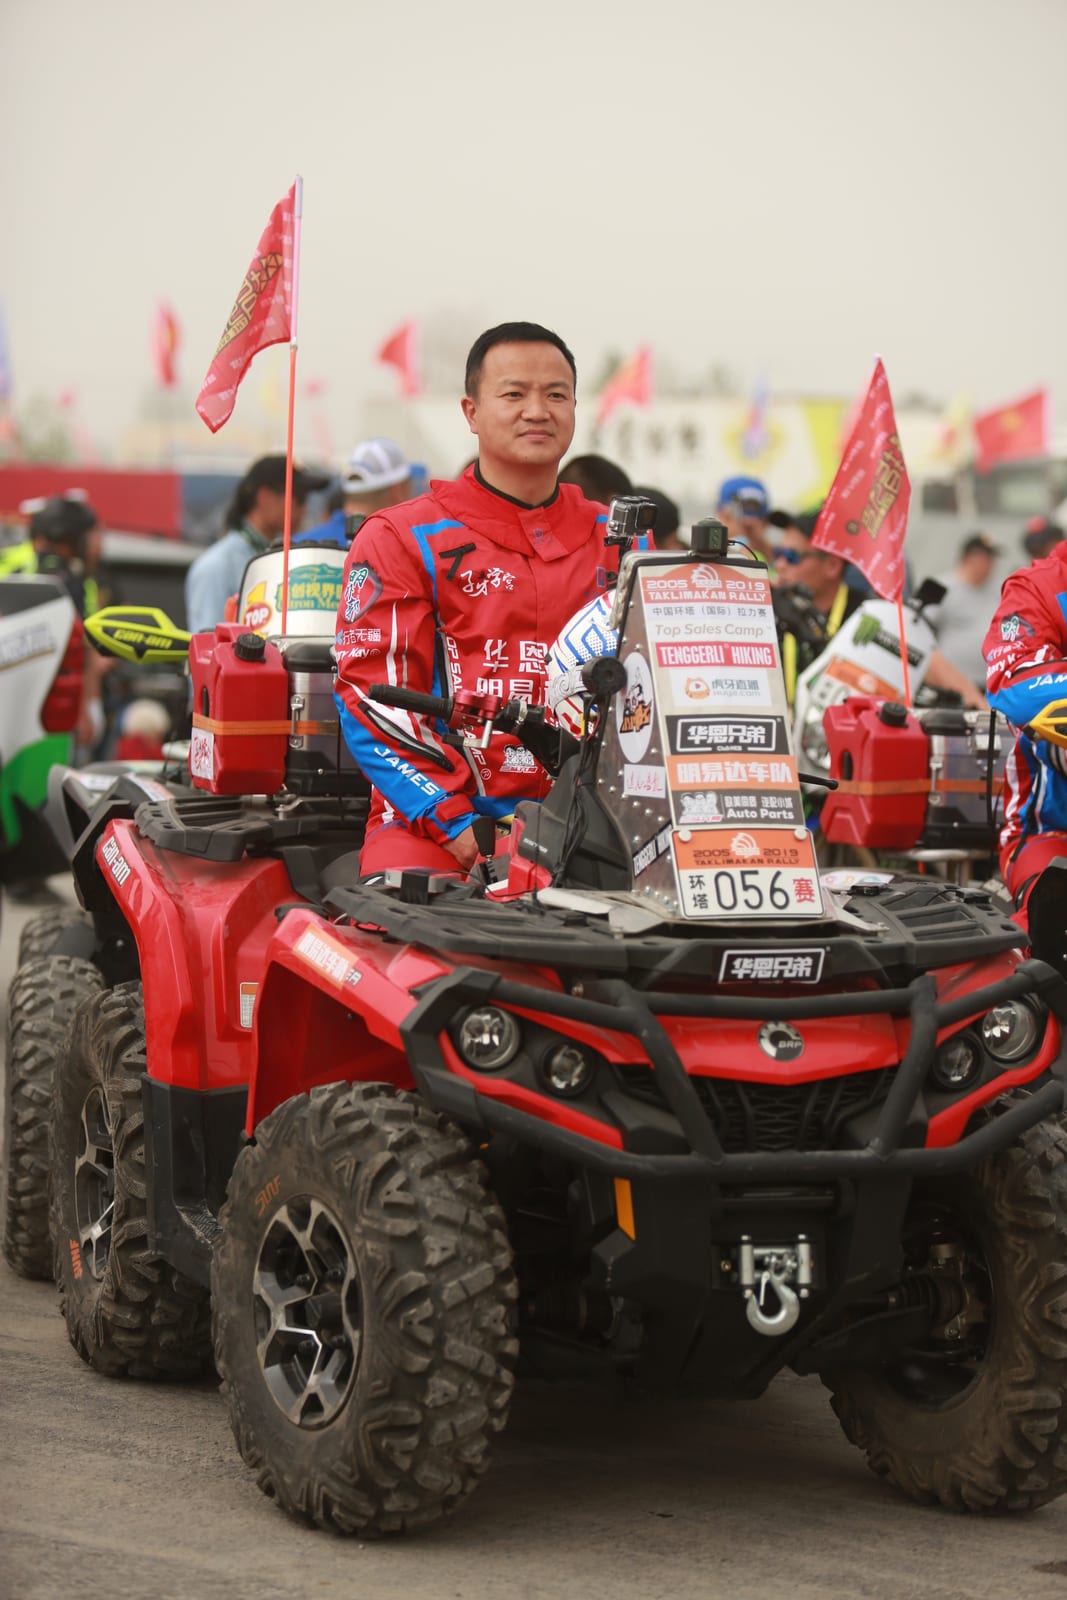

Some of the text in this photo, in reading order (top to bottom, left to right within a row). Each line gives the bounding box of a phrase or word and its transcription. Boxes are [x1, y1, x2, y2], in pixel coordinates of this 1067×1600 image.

[646, 579, 766, 591] 2005 2019
[648, 591, 767, 602] TAKLIMAKAN RALLY
[245, 607, 269, 627] TOP
[655, 623, 764, 639] Top Sales Camp
[446, 636, 459, 660] OP
[659, 645, 772, 666] TENGGERLI HIKING
[450, 661, 463, 693] SAL
[687, 725, 767, 744] 华恩兄弟
[373, 747, 440, 796] JAMES
[677, 761, 793, 784] 明易达车队
[726, 808, 758, 819] Auto
[760, 808, 795, 820] Parts
[692, 848, 798, 858] 2005 2019
[695, 858, 800, 866] TAKLIMAKAN RALLY
[689, 874, 709, 910] 环塔
[714, 870, 791, 911] 056
[792, 877, 815, 904] 赛
[731, 956, 813, 979] 华恩兄弟
[778, 1040, 802, 1049] BRP
